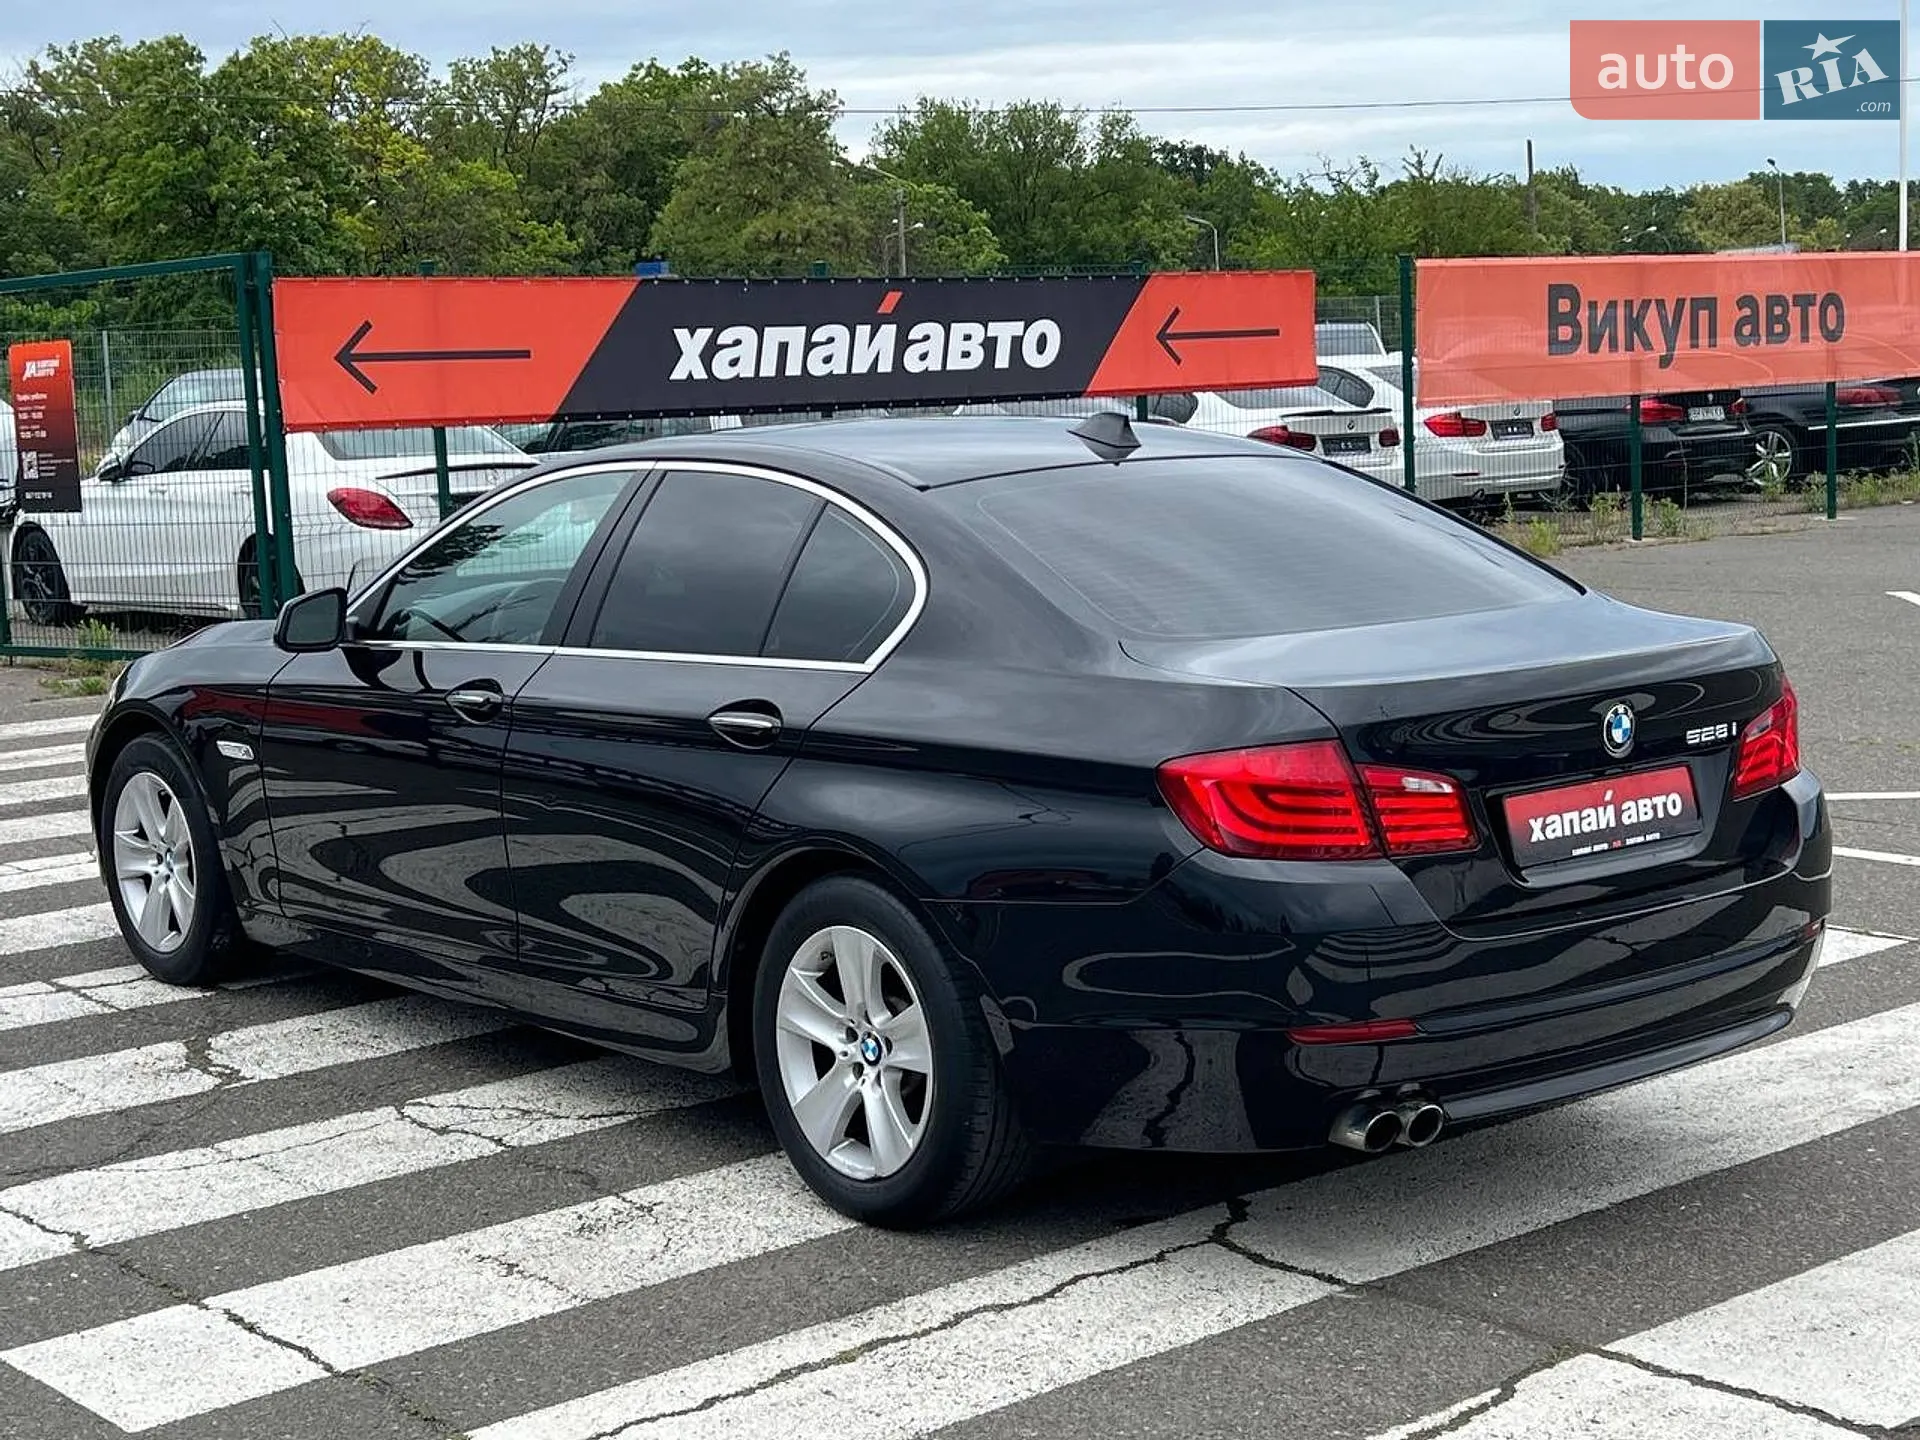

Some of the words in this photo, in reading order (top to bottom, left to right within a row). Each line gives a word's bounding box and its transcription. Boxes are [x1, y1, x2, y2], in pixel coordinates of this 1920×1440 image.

[669, 291, 902, 381] хапай
[903, 319, 1062, 372] авто
[1547, 283, 1718, 369] Викуп
[1734, 291, 1845, 347] авто
[1528, 789, 1617, 843] хапай
[1621, 792, 1683, 826] авто
